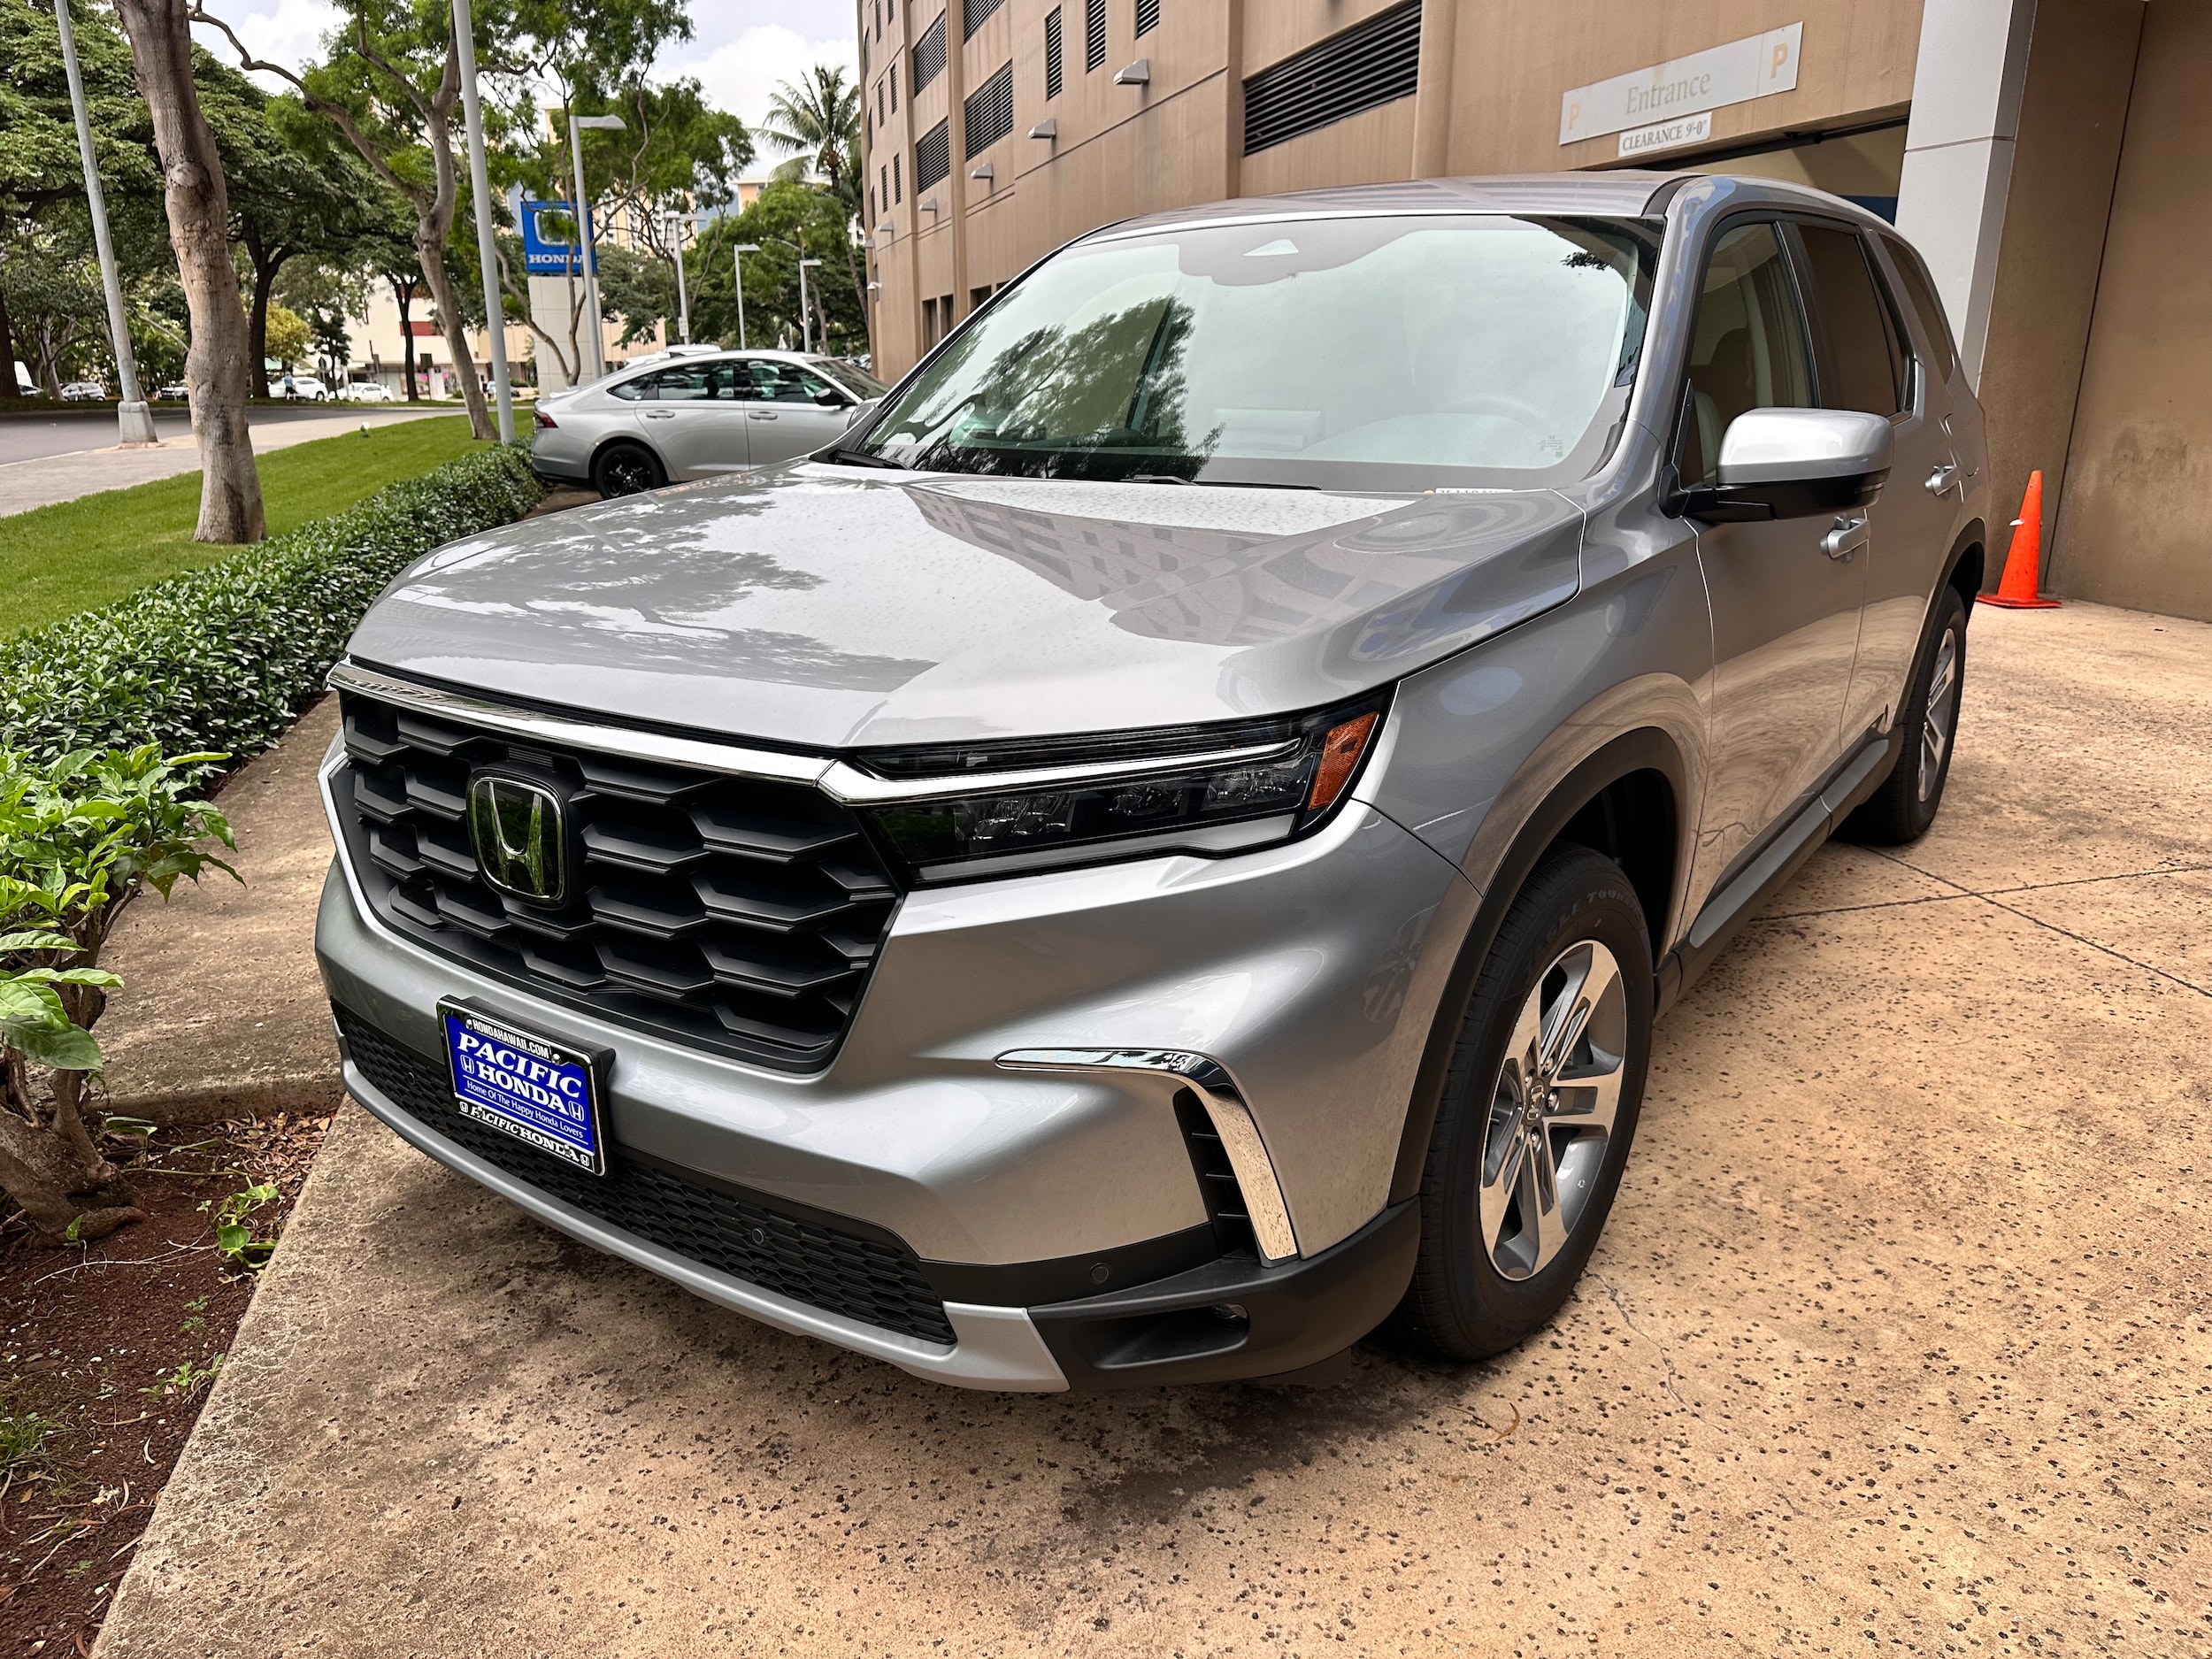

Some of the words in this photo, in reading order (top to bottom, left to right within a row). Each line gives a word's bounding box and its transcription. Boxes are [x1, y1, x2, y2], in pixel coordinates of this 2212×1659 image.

[1568, 102, 1581, 130] P
[1625, 73, 1711, 114] Entrance
[1770, 42, 1788, 79] P
[1622, 125, 1683, 151] CLEARANCE
[457, 1032, 581, 1098] PACIFIC
[472, 1018, 549, 1059] HONDAHAWAII.COM
[466, 1080, 487, 1096] Home
[488, 1091, 497, 1102] Of
[497, 1094, 511, 1107] The
[511, 1100, 534, 1118] Happy
[535, 1110, 558, 1128] Honda
[560, 1121, 584, 1139] Lovers
[477, 1061, 569, 1116] HONDA
[470, 1105, 520, 1134] PACIFIC
